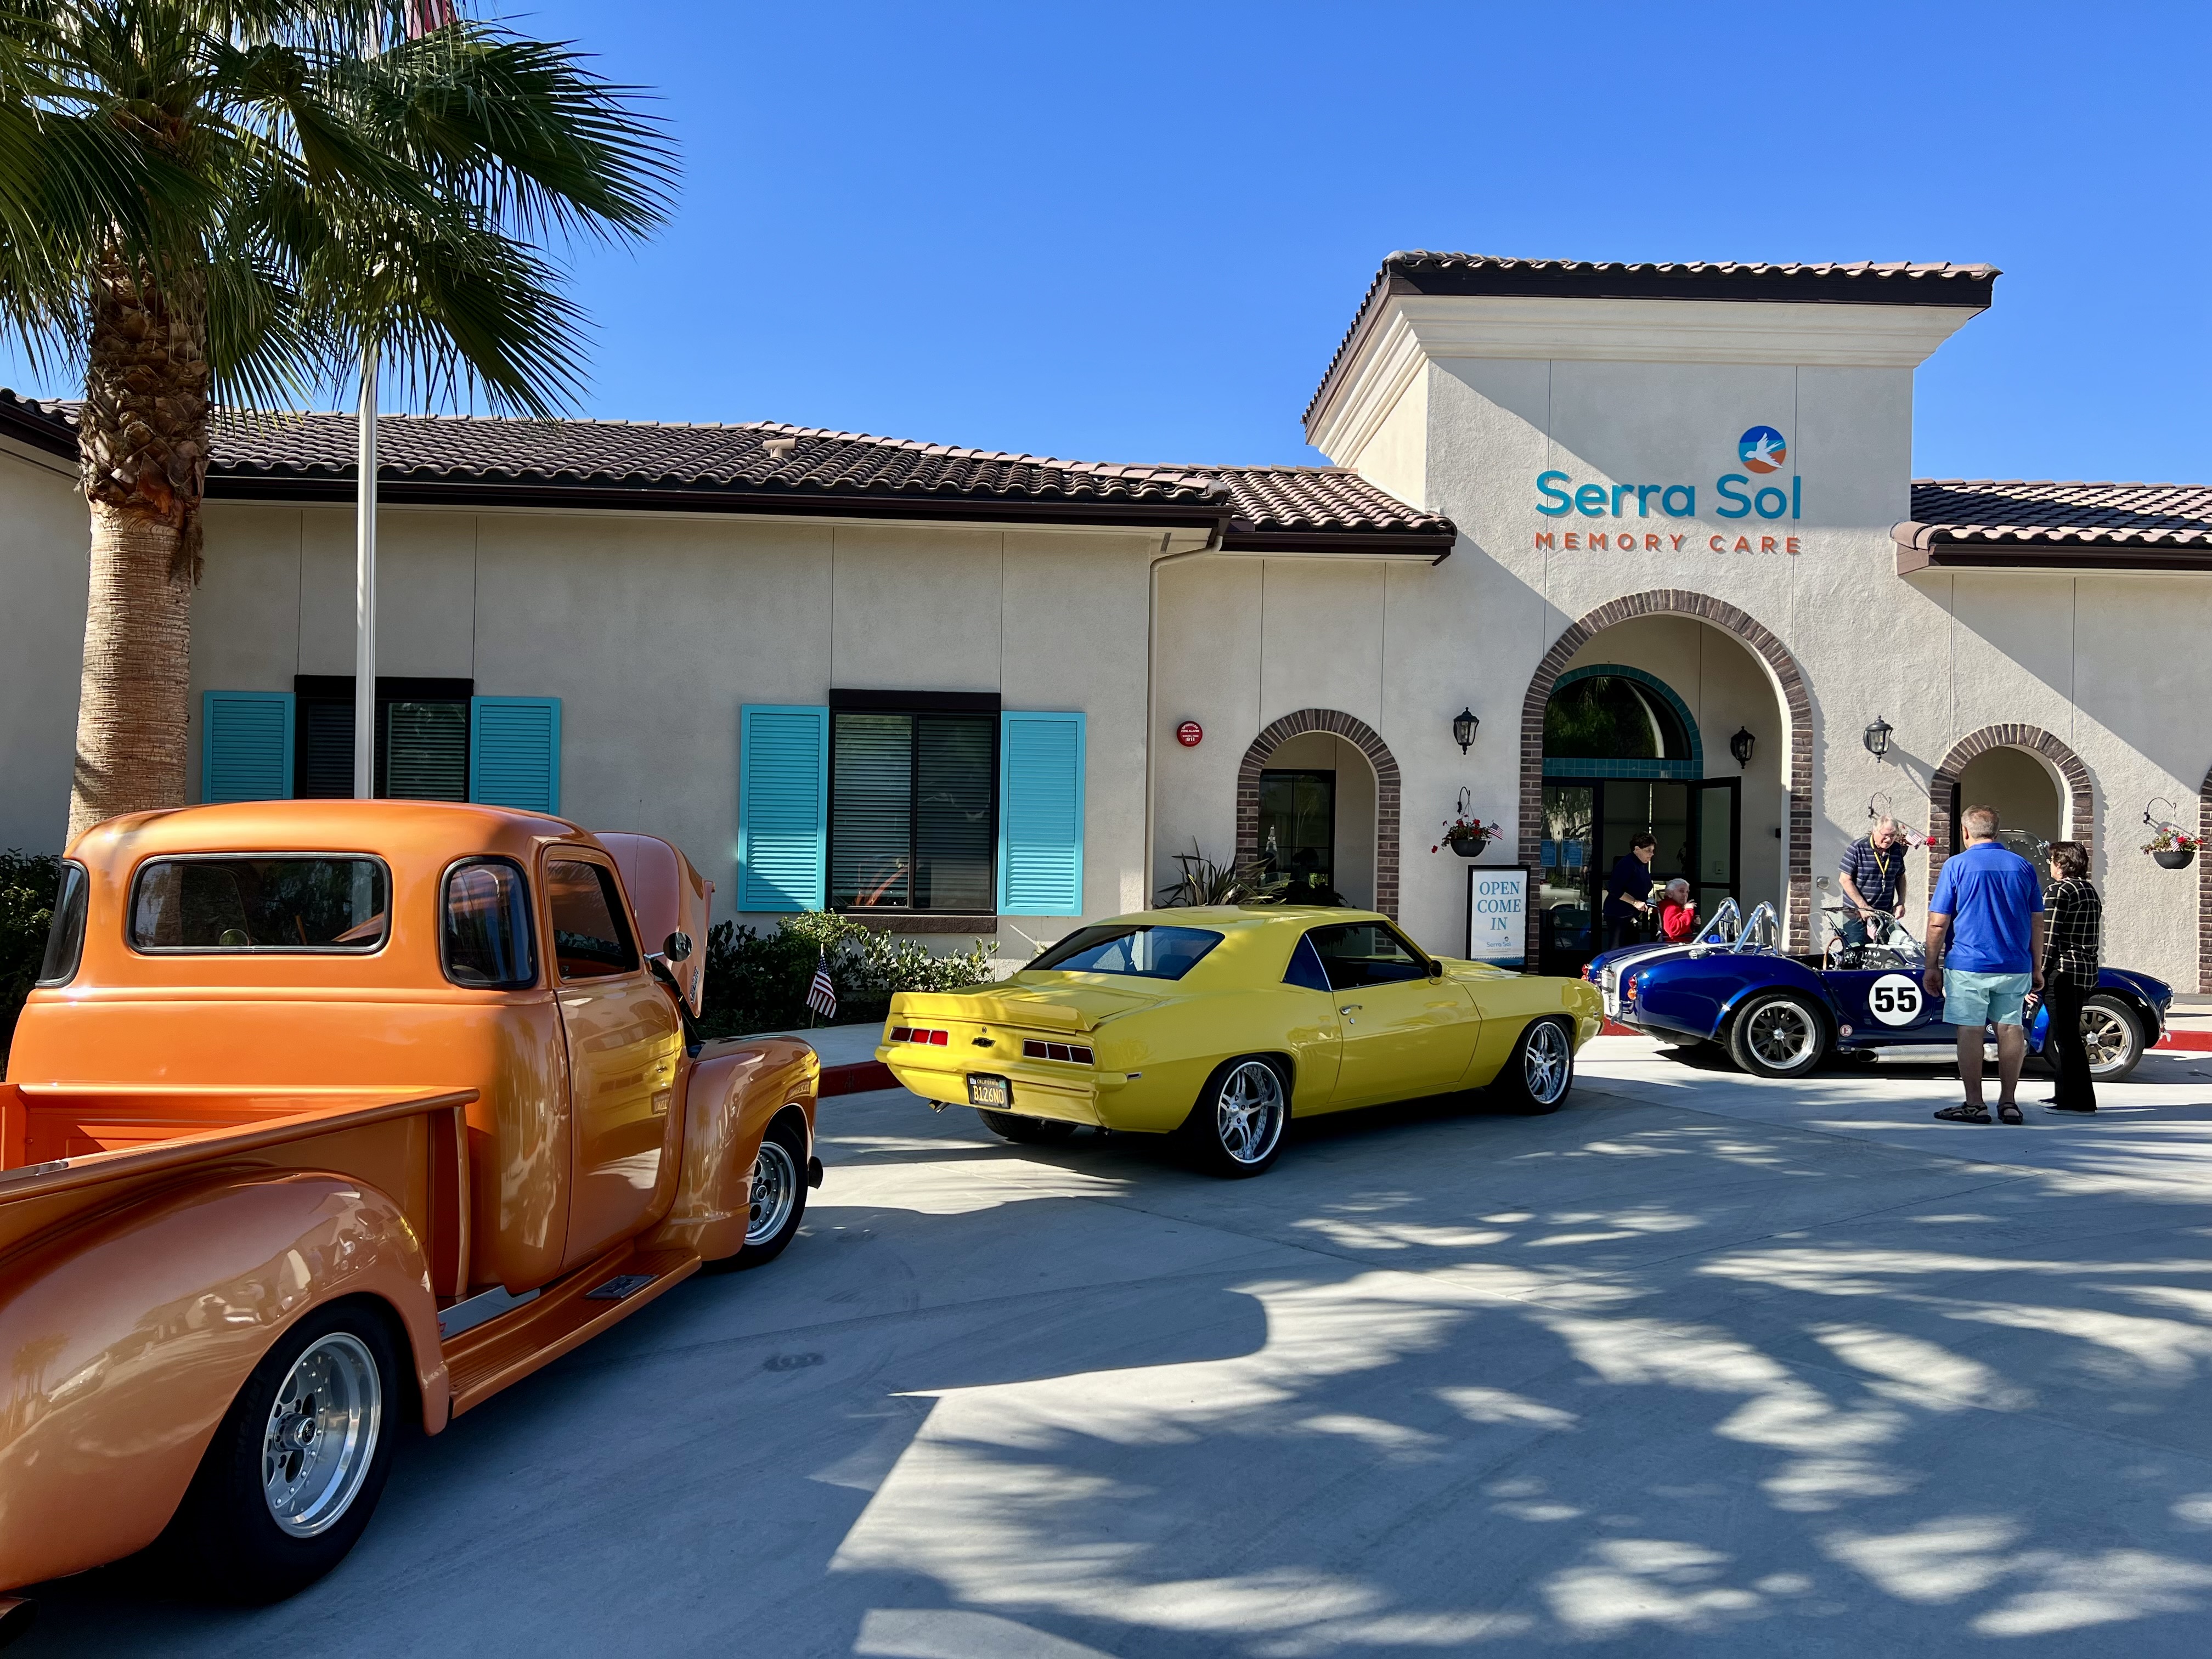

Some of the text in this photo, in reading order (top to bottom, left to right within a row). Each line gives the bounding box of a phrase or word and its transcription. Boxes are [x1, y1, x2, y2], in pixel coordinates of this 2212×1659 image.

[1535, 470, 1801, 520] Serra Sol
[1536, 532, 1800, 554] MEMORY CARE
[1479, 881, 1520, 895] OPEN
[1477, 899, 1521, 913] COME
[1490, 917, 1508, 930] IN
[1875, 986, 1917, 1013] 55
